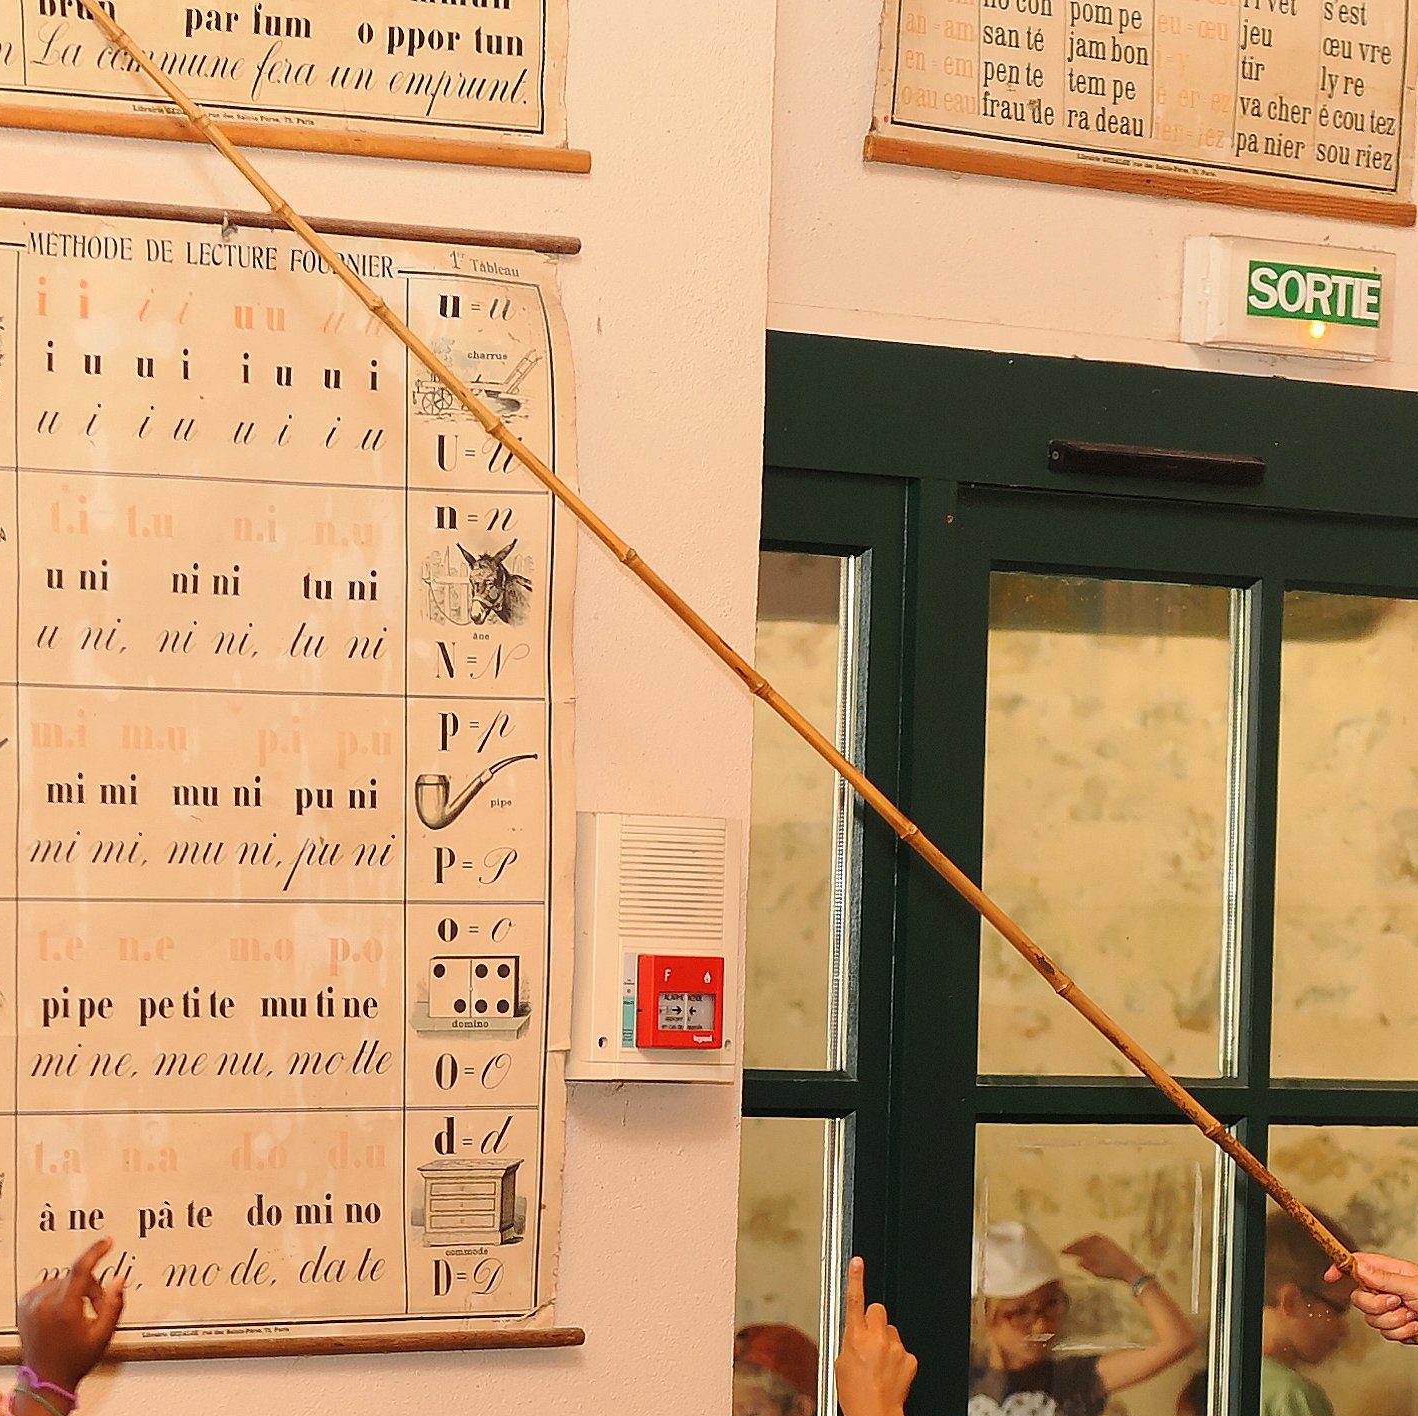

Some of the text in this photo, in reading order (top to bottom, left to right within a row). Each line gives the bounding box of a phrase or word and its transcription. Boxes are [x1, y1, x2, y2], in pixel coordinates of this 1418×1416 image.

[30, 21, 82, 67] La
[185, 7, 238, 38] par
[474, 26, 525, 57] tun
[1240, 19, 1273, 50] jeu
[146, 238, 174, 263] DE
[186, 241, 278, 271] LECTURE
[469, 258, 520, 278] Tableau
[1248, 266, 1380, 322] SORTIE
